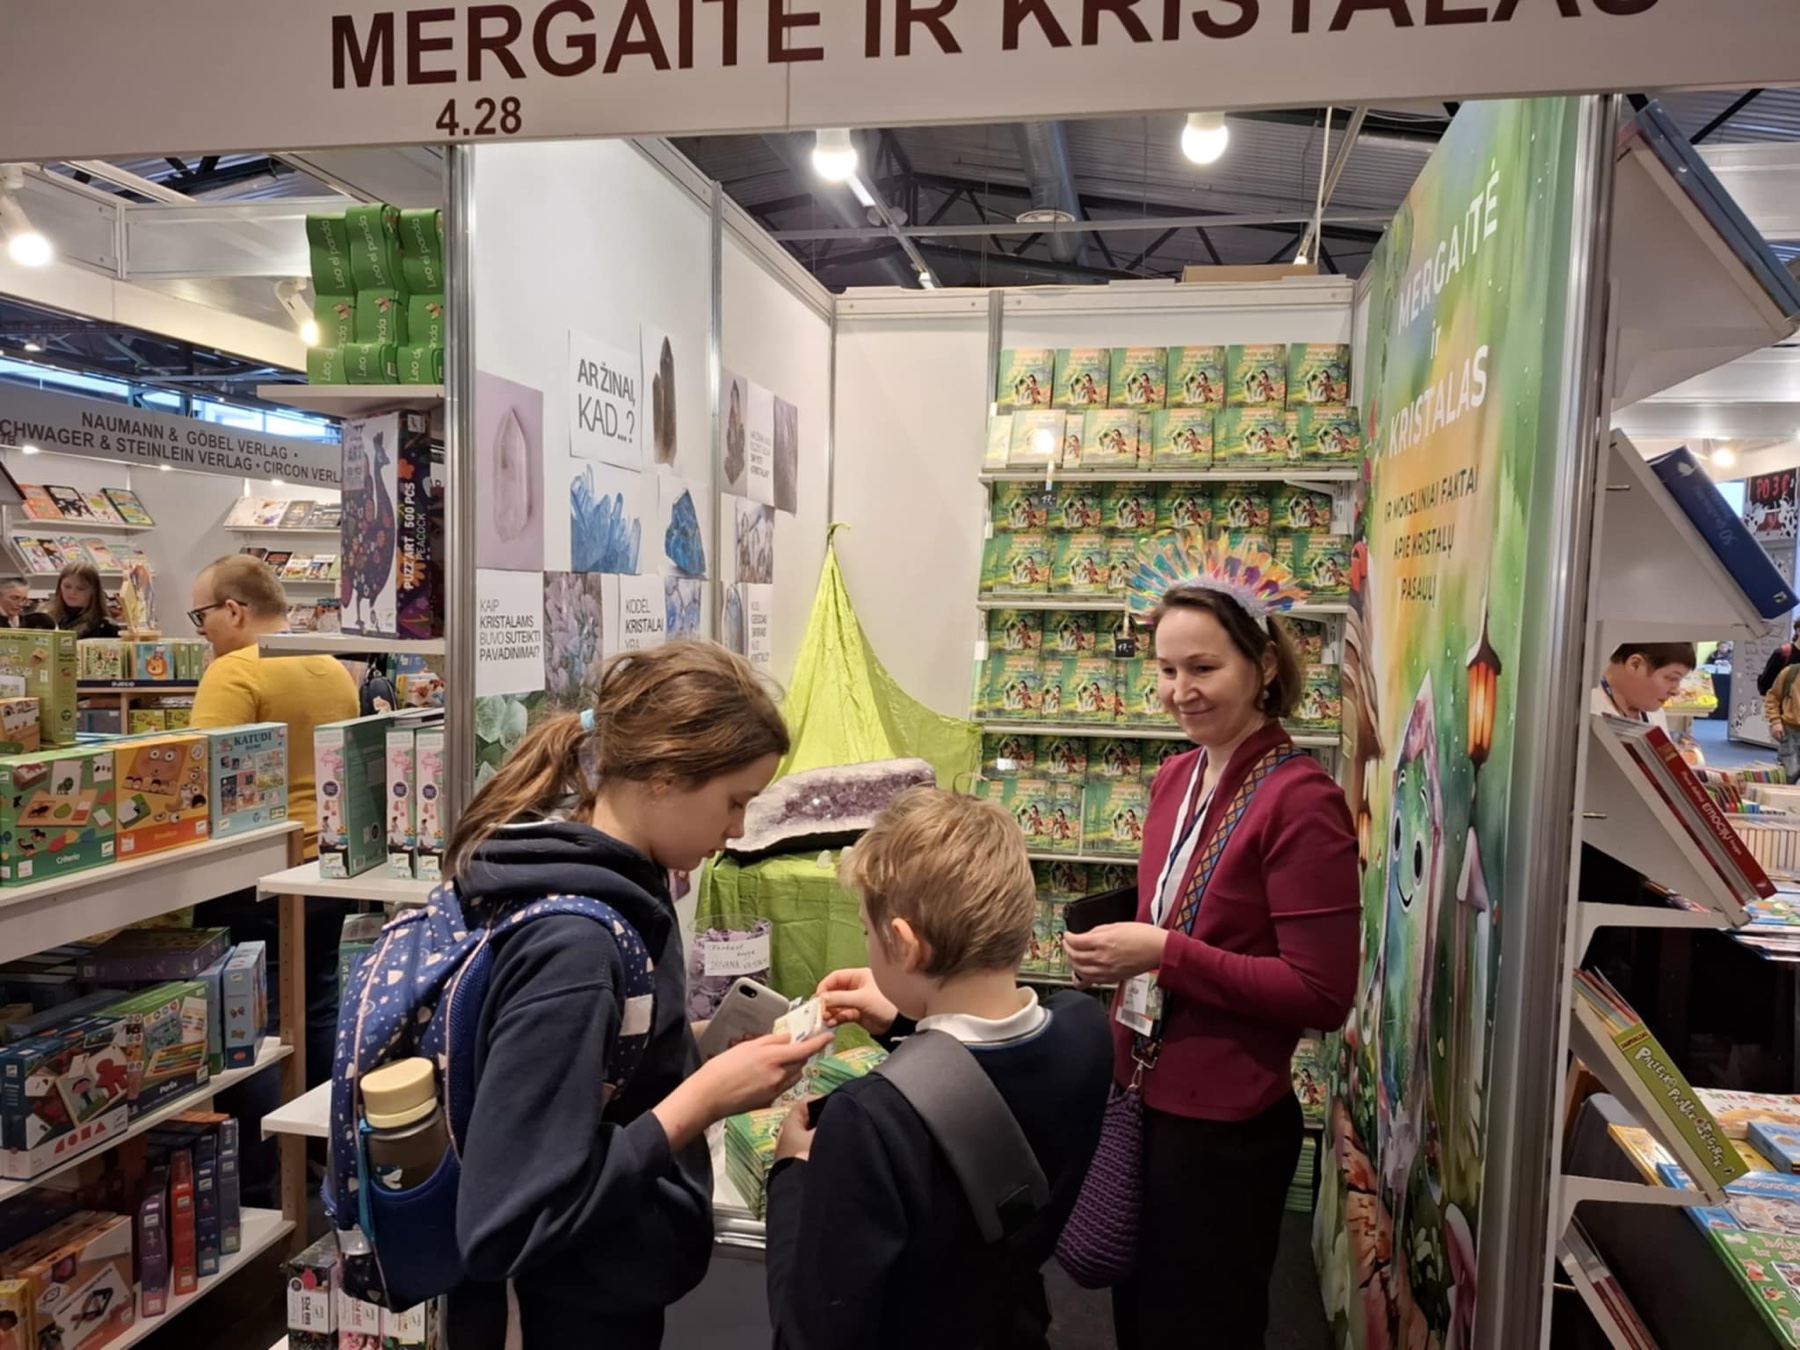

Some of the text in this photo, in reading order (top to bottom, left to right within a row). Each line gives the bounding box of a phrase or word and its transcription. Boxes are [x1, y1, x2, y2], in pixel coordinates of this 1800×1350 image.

[1000, 0, 1660, 52] KRIST
[435, 97, 522, 137] 4.28
[1397, 158, 1499, 335] MERGAITĖ
[1430, 320, 1443, 360] ir
[409, 361, 421, 382] Leo
[577, 358, 599, 389] AR
[577, 394, 636, 443] KAD...?
[1388, 345, 1490, 457] KRISTALAS
[82, 411, 288, 460] NAUMANN & GÖBEL VERLAG
[99, 435, 111, 450] &
[116, 437, 195, 463] STEINLEIN
[197, 450, 253, 471] VERLAG
[263, 460, 309, 479] CIRCON
[311, 470, 342, 484] VERL
[405, 481, 416, 503] PCS
[1439, 465, 1479, 505] FAKTAI
[405, 506, 415, 528] 500
[416, 513, 426, 560] PEACOCK
[480, 614, 535, 629] KRISTALAMS
